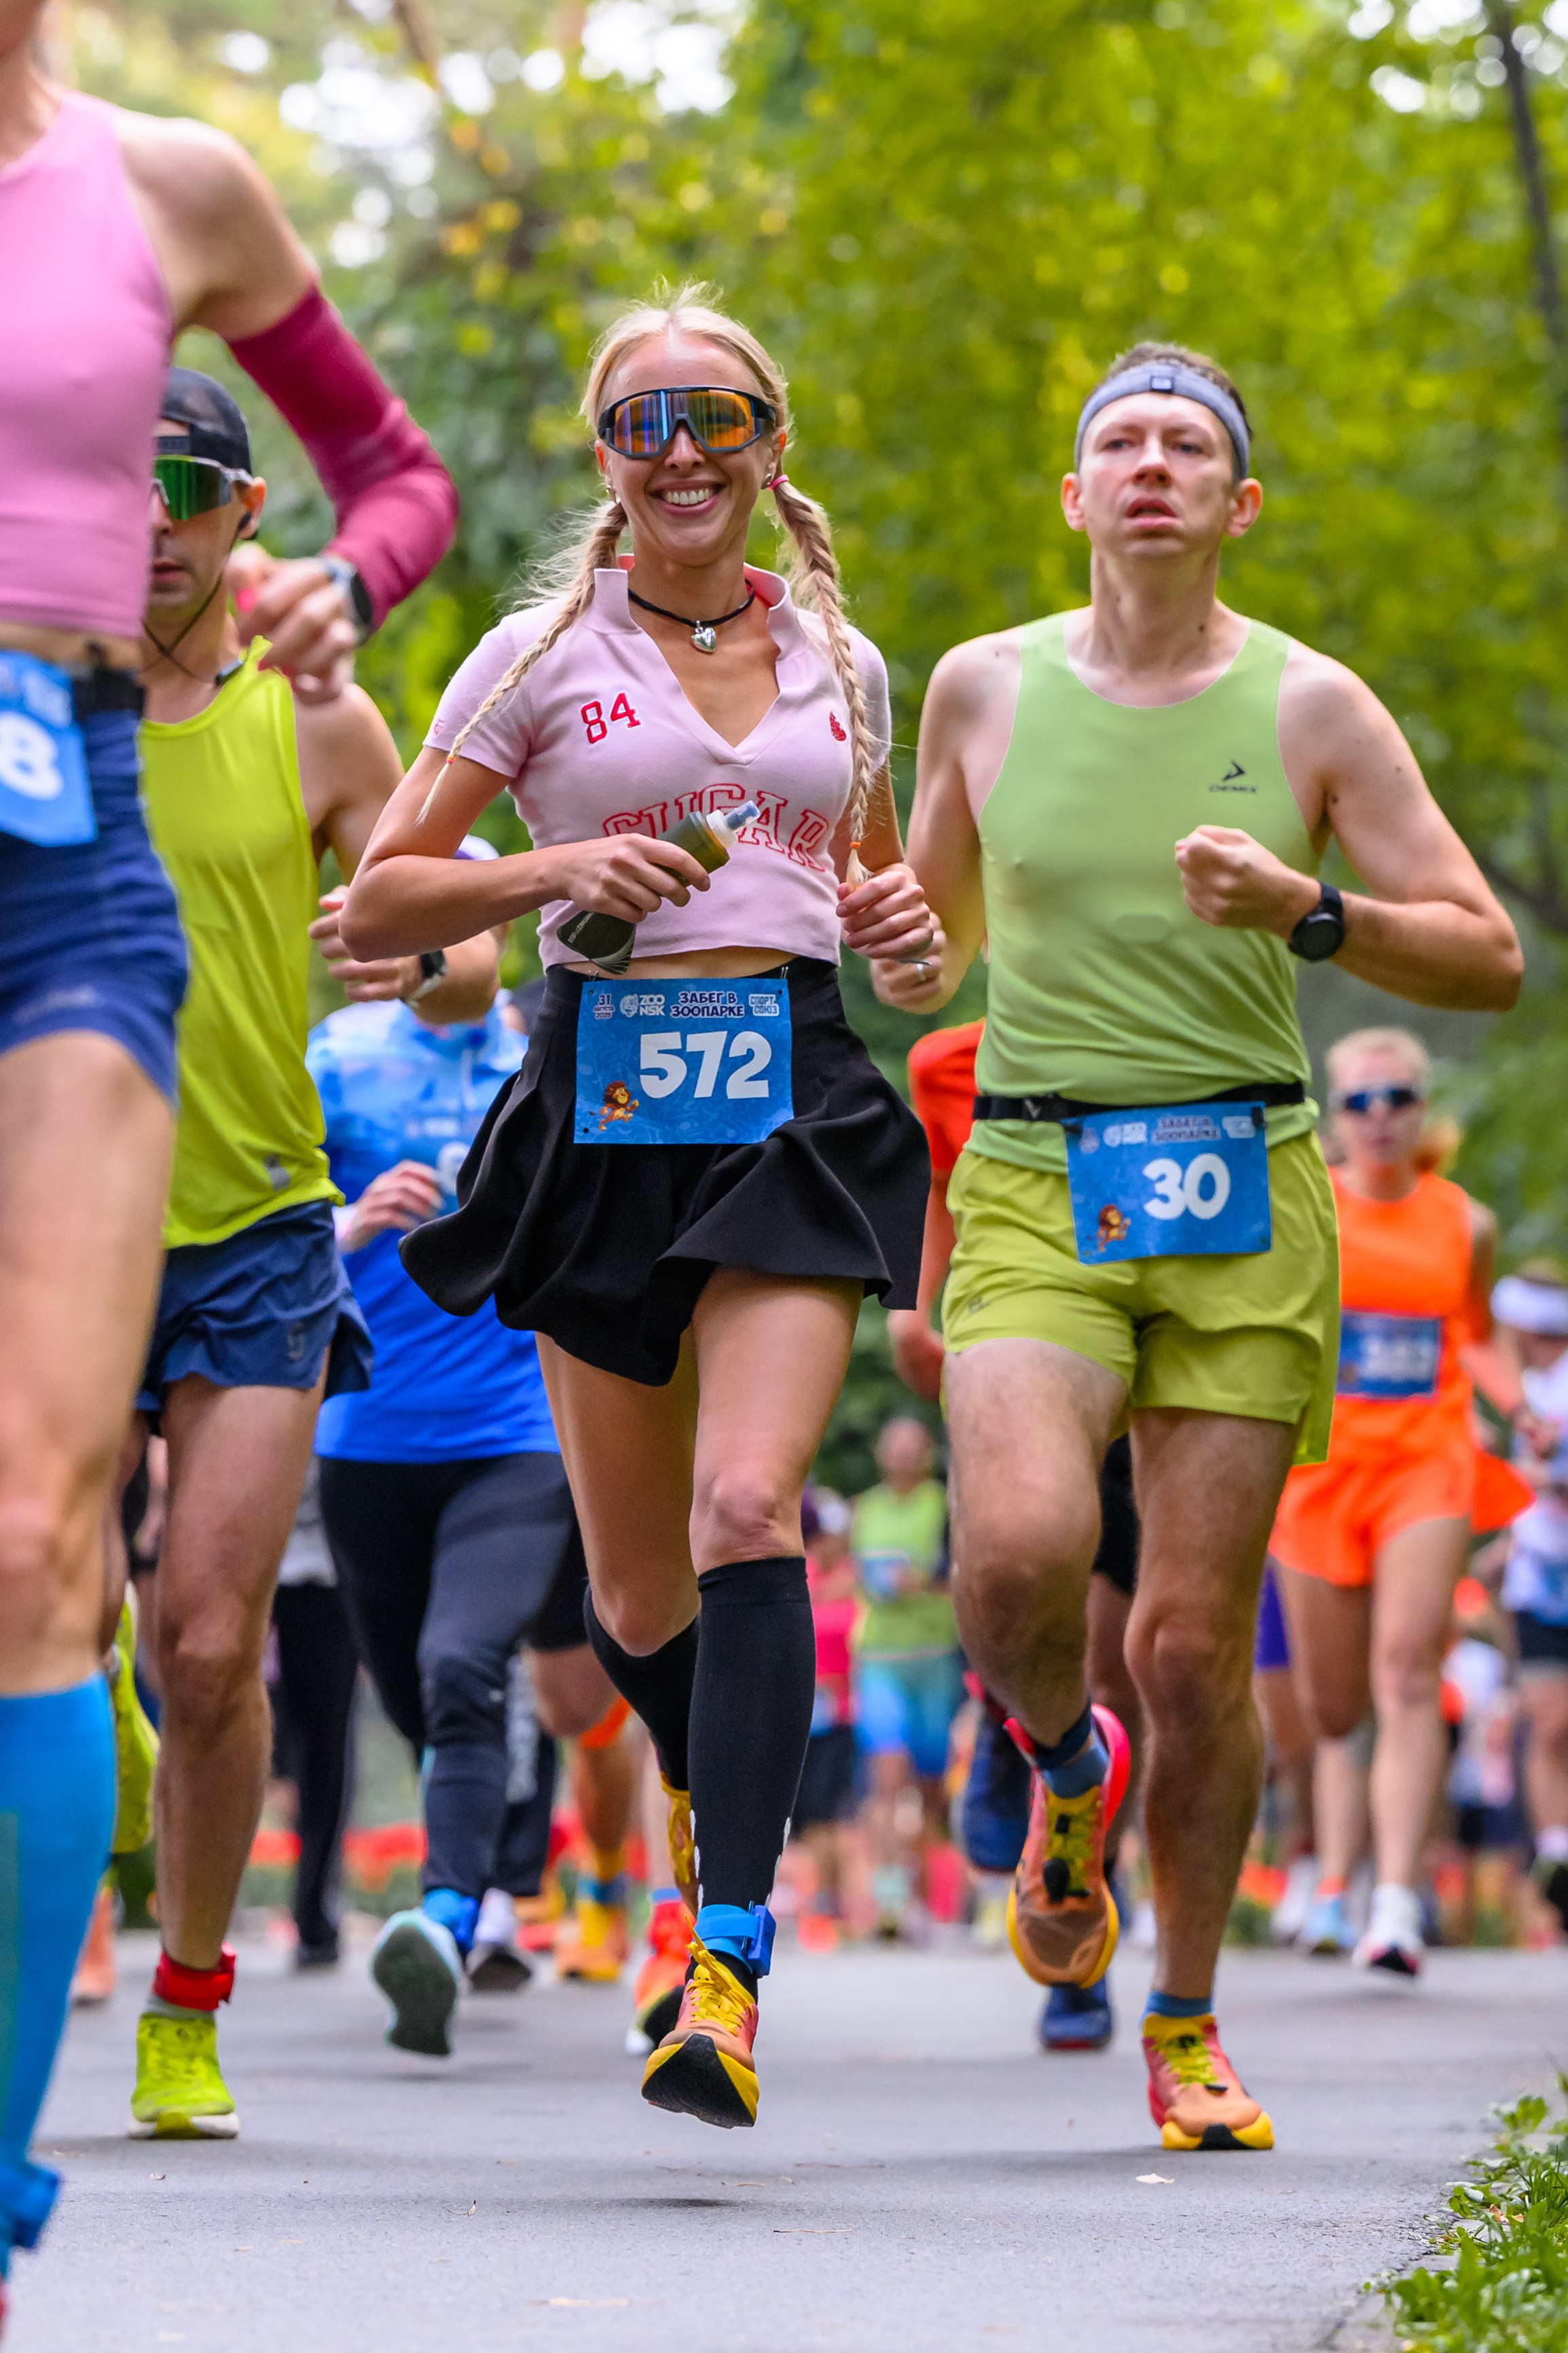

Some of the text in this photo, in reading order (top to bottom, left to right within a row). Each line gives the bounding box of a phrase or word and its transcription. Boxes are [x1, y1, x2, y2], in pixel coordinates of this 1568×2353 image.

[581, 692, 641, 744] 84
[598, 994, 610, 1005] 31
[639, 994, 666, 1006] ZOO
[680, 992, 736, 1004] ЗАБЕГ В
[639, 1005, 666, 1016] NSK
[672, 1005, 744, 1017] ЗООПАРКЕ
[640, 1031, 771, 1099] 572
[1142, 1153, 1230, 1220] 30
